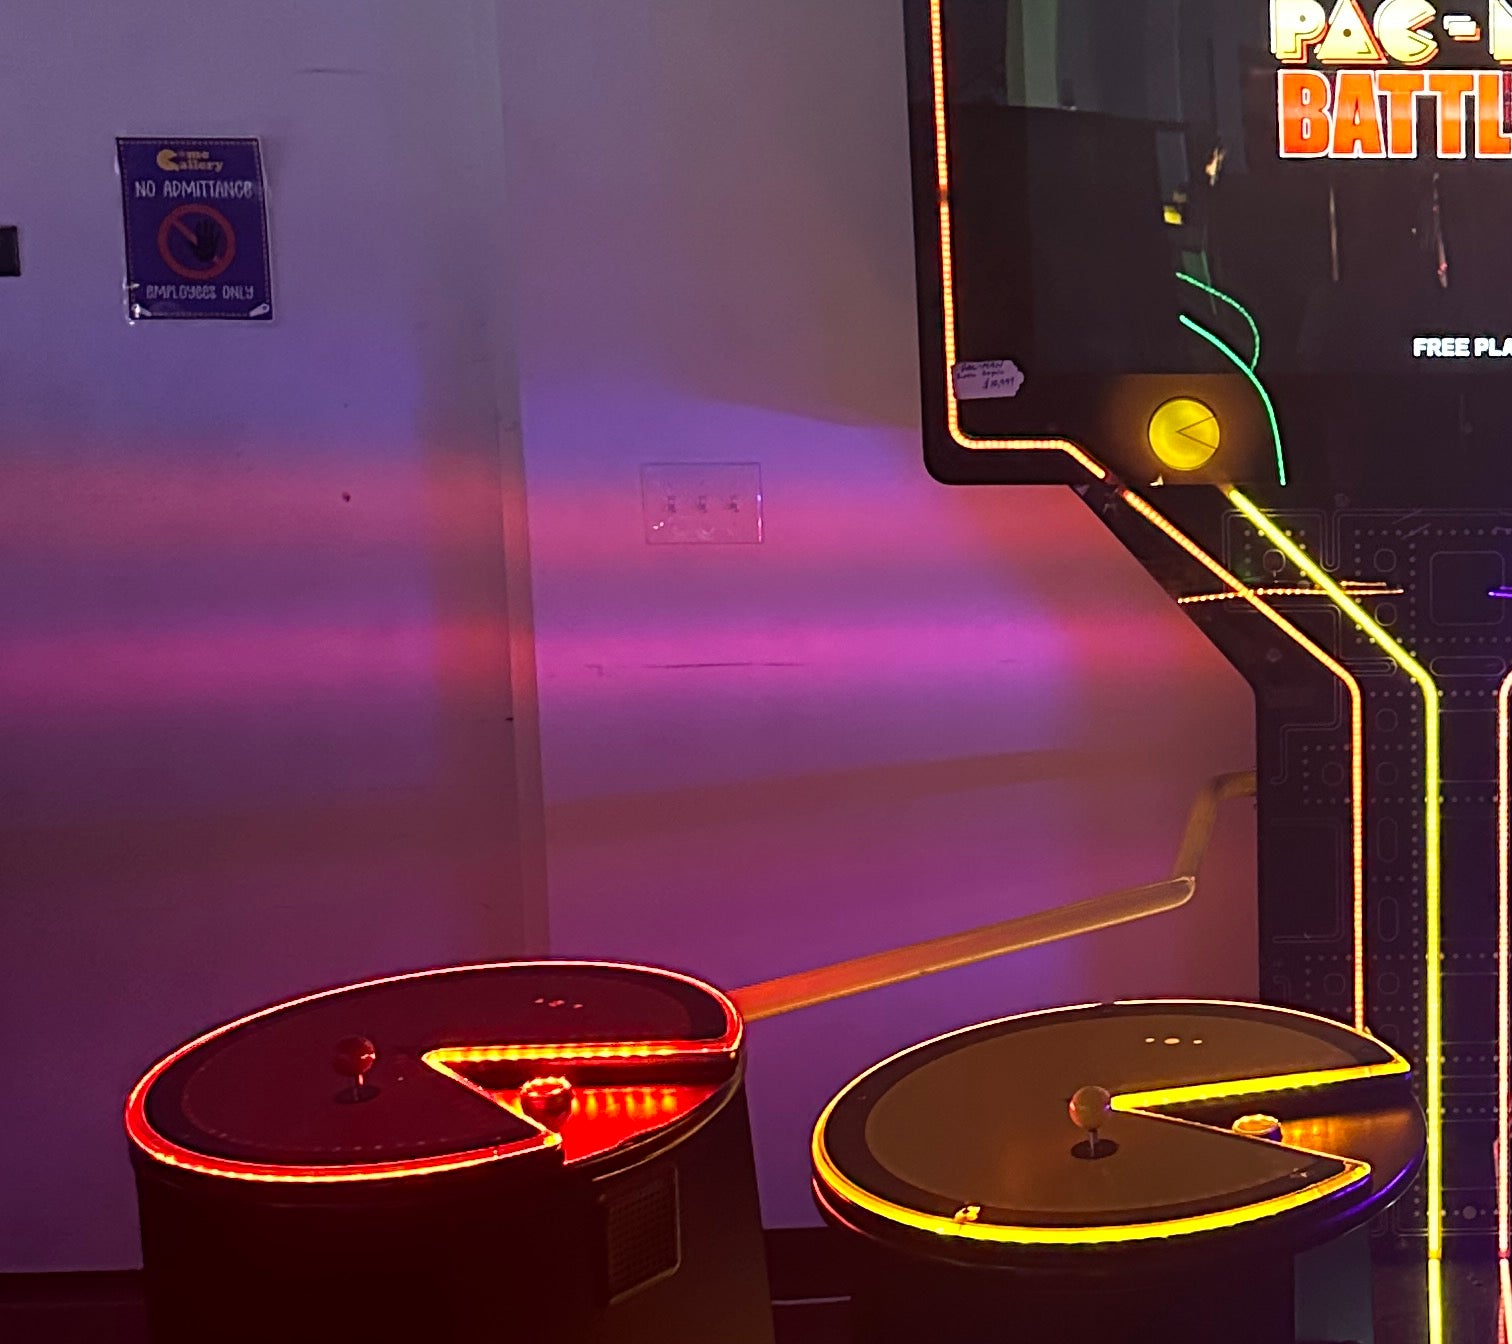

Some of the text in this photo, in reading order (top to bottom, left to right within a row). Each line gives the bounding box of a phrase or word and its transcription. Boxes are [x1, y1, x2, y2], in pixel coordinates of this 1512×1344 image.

[135, 179, 253, 199] NO ADMITTANCE
[147, 283, 254, 300] EMPLOYEES ONLY
[1412, 337, 1470, 357] FREE
